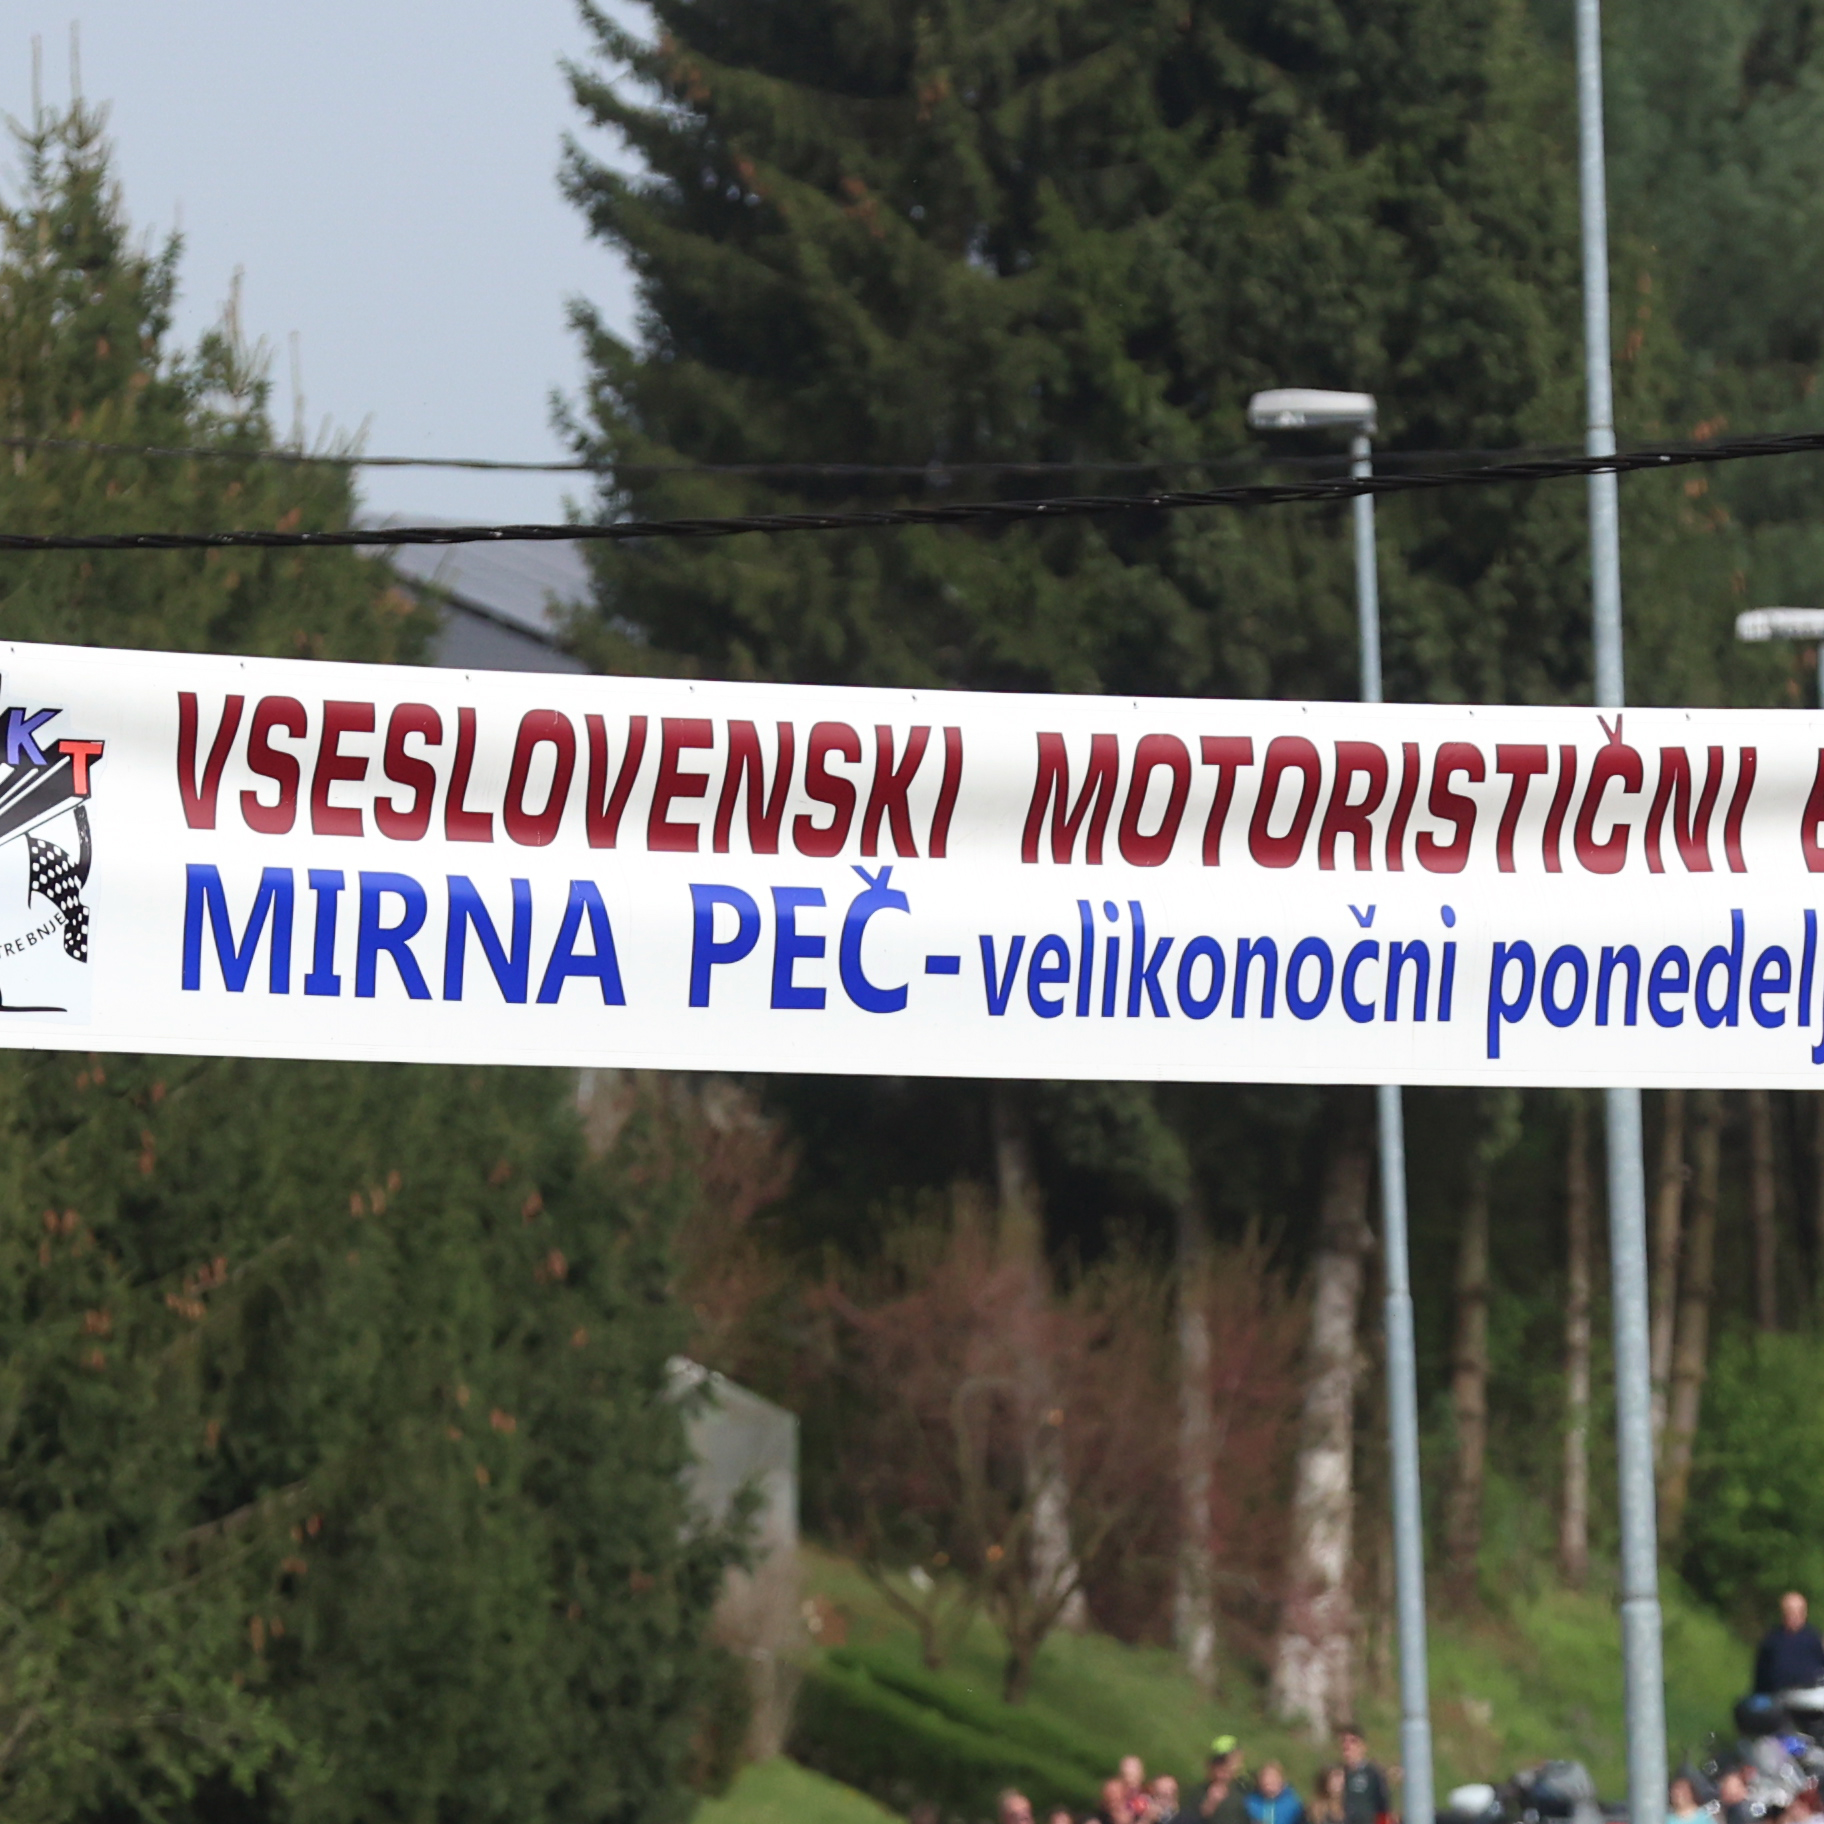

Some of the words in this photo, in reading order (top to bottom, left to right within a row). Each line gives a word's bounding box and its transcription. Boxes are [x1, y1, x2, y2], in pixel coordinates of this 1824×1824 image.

[177, 691, 963, 860] VSESLOVENSKI
[1021, 713, 1758, 876] MOTORISTIČNI
[181, 862, 627, 1007] MIRNA
